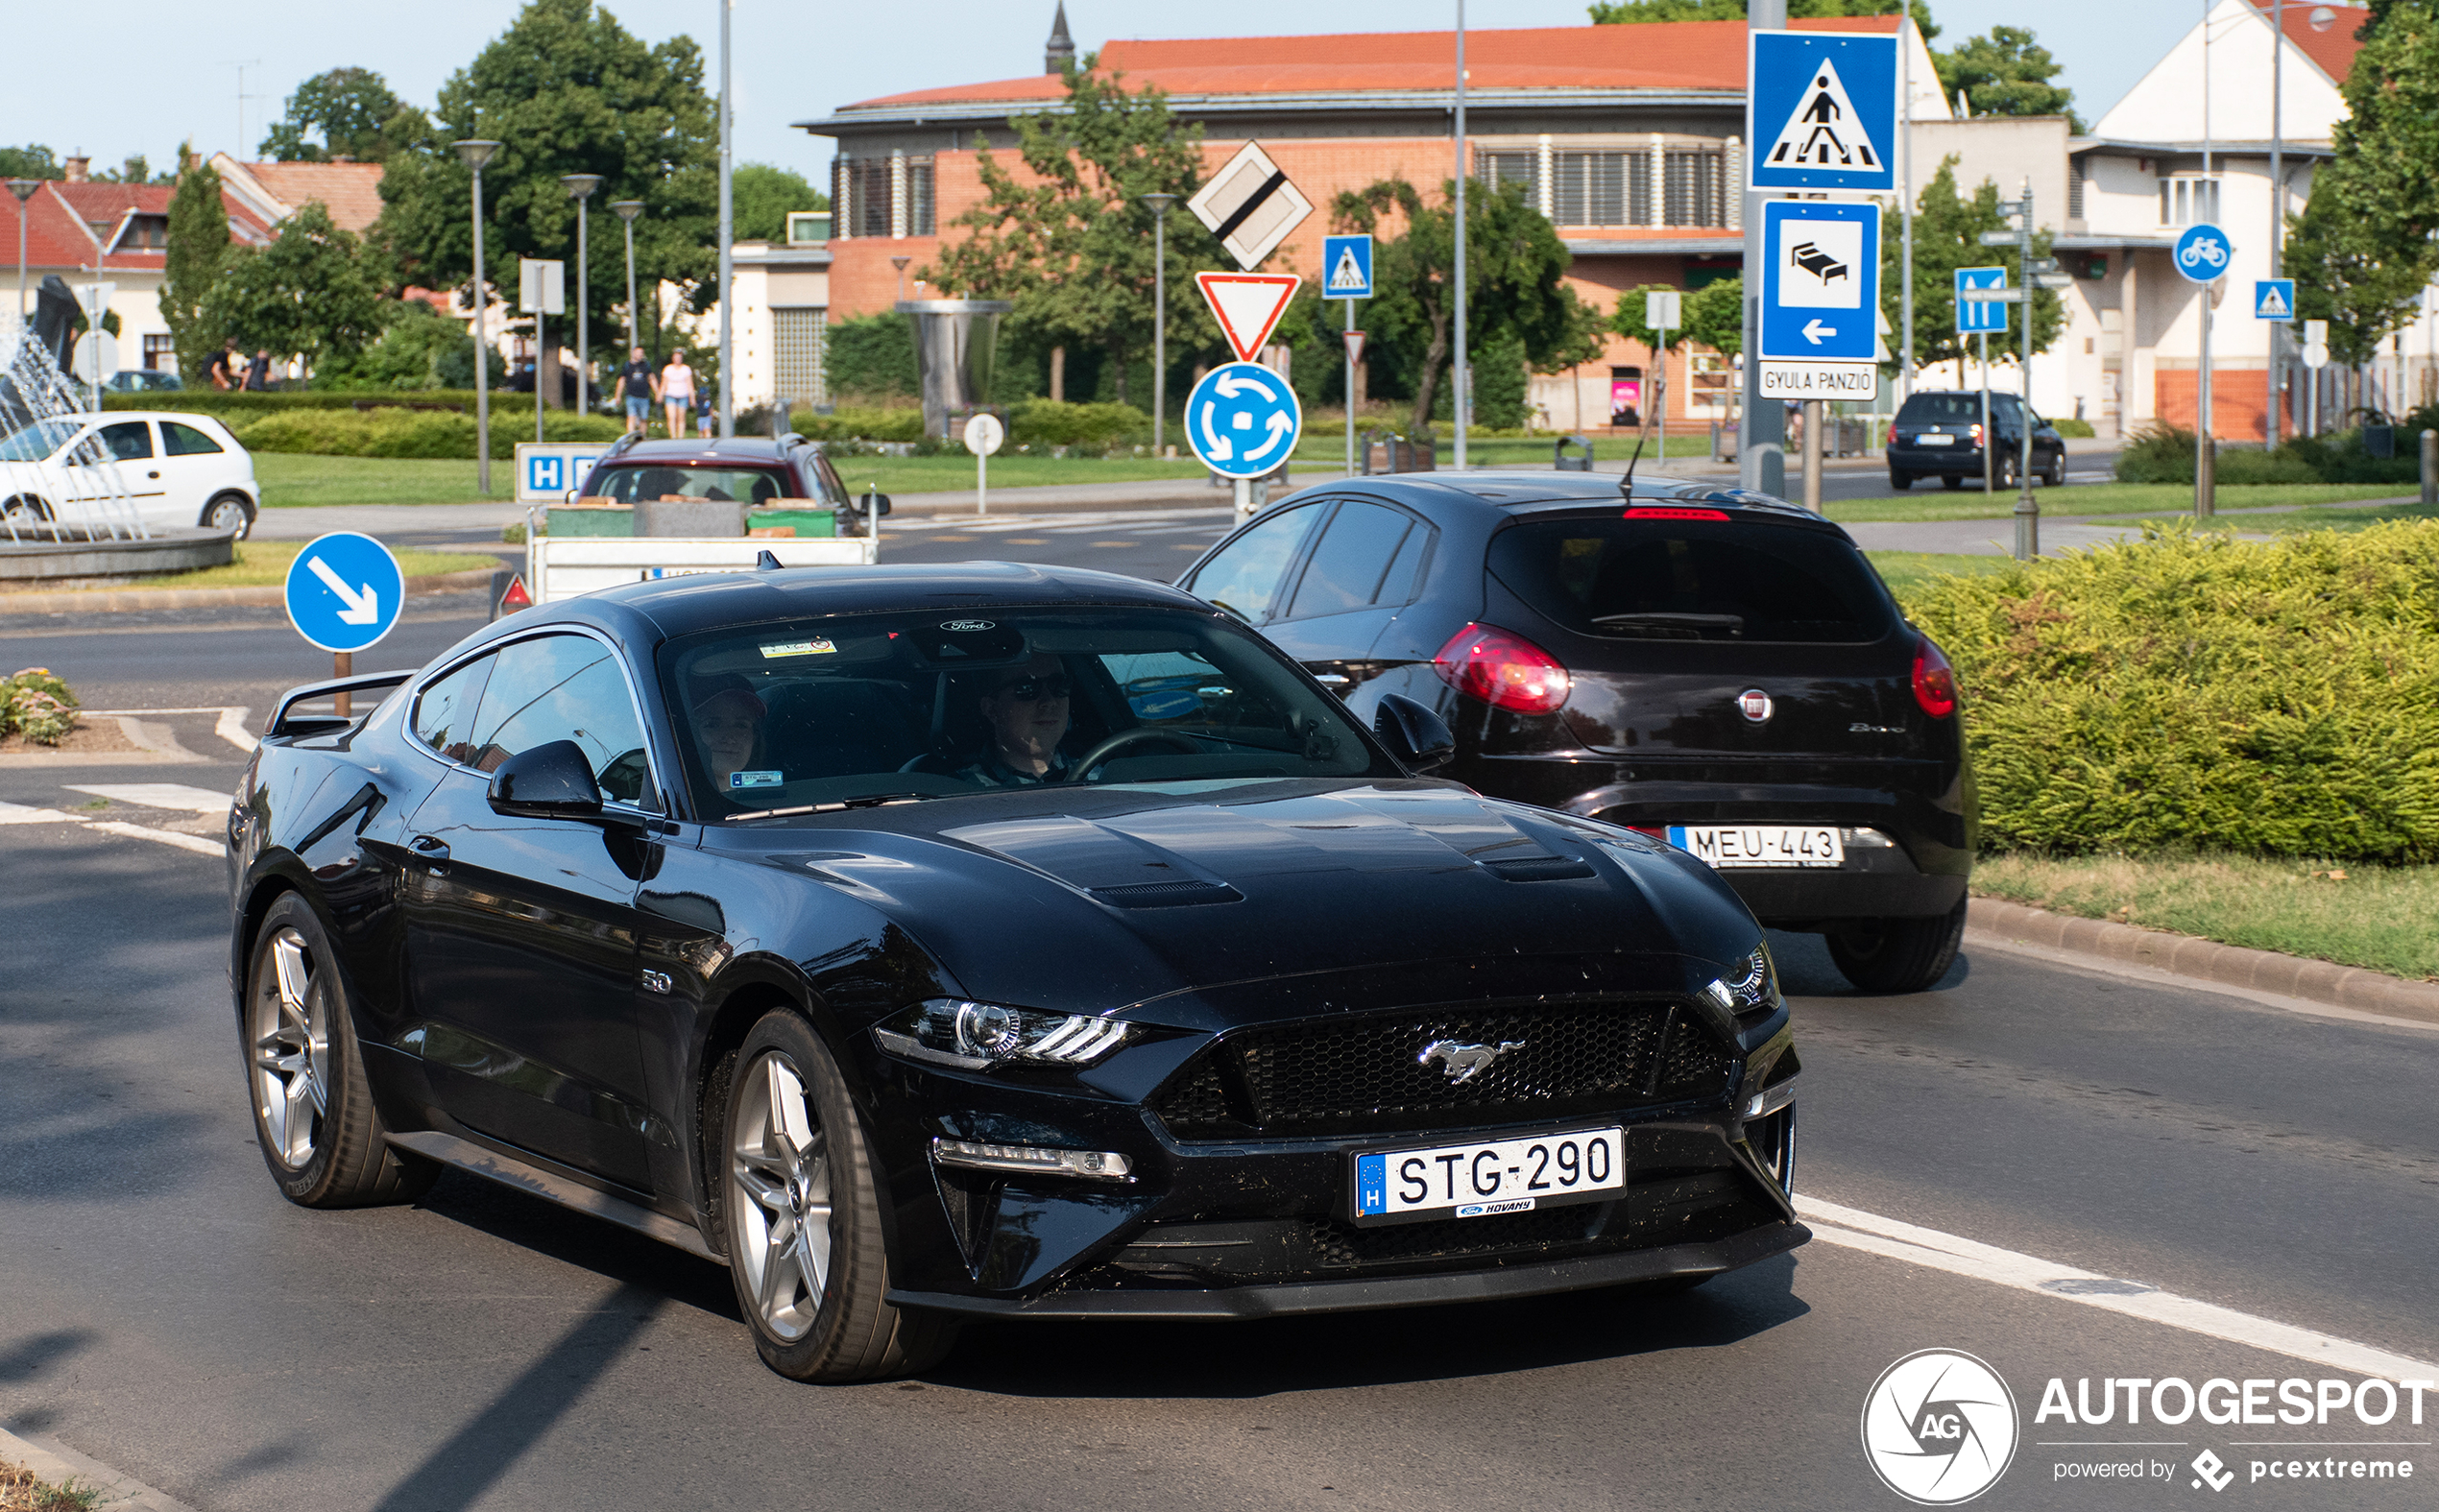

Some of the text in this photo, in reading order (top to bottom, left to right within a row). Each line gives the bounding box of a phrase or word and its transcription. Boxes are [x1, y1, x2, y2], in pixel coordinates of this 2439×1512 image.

[1766, 368, 1871, 391] GYULA PANZIÓ
[535, 460, 558, 488] H
[951, 621, 986, 631] Ford
[1693, 829, 1834, 859] MEU-443
[1398, 1138, 1610, 1205] STG-290
[1365, 1189, 1380, 1208] H
[1485, 1200, 1531, 1213] HOVANY
